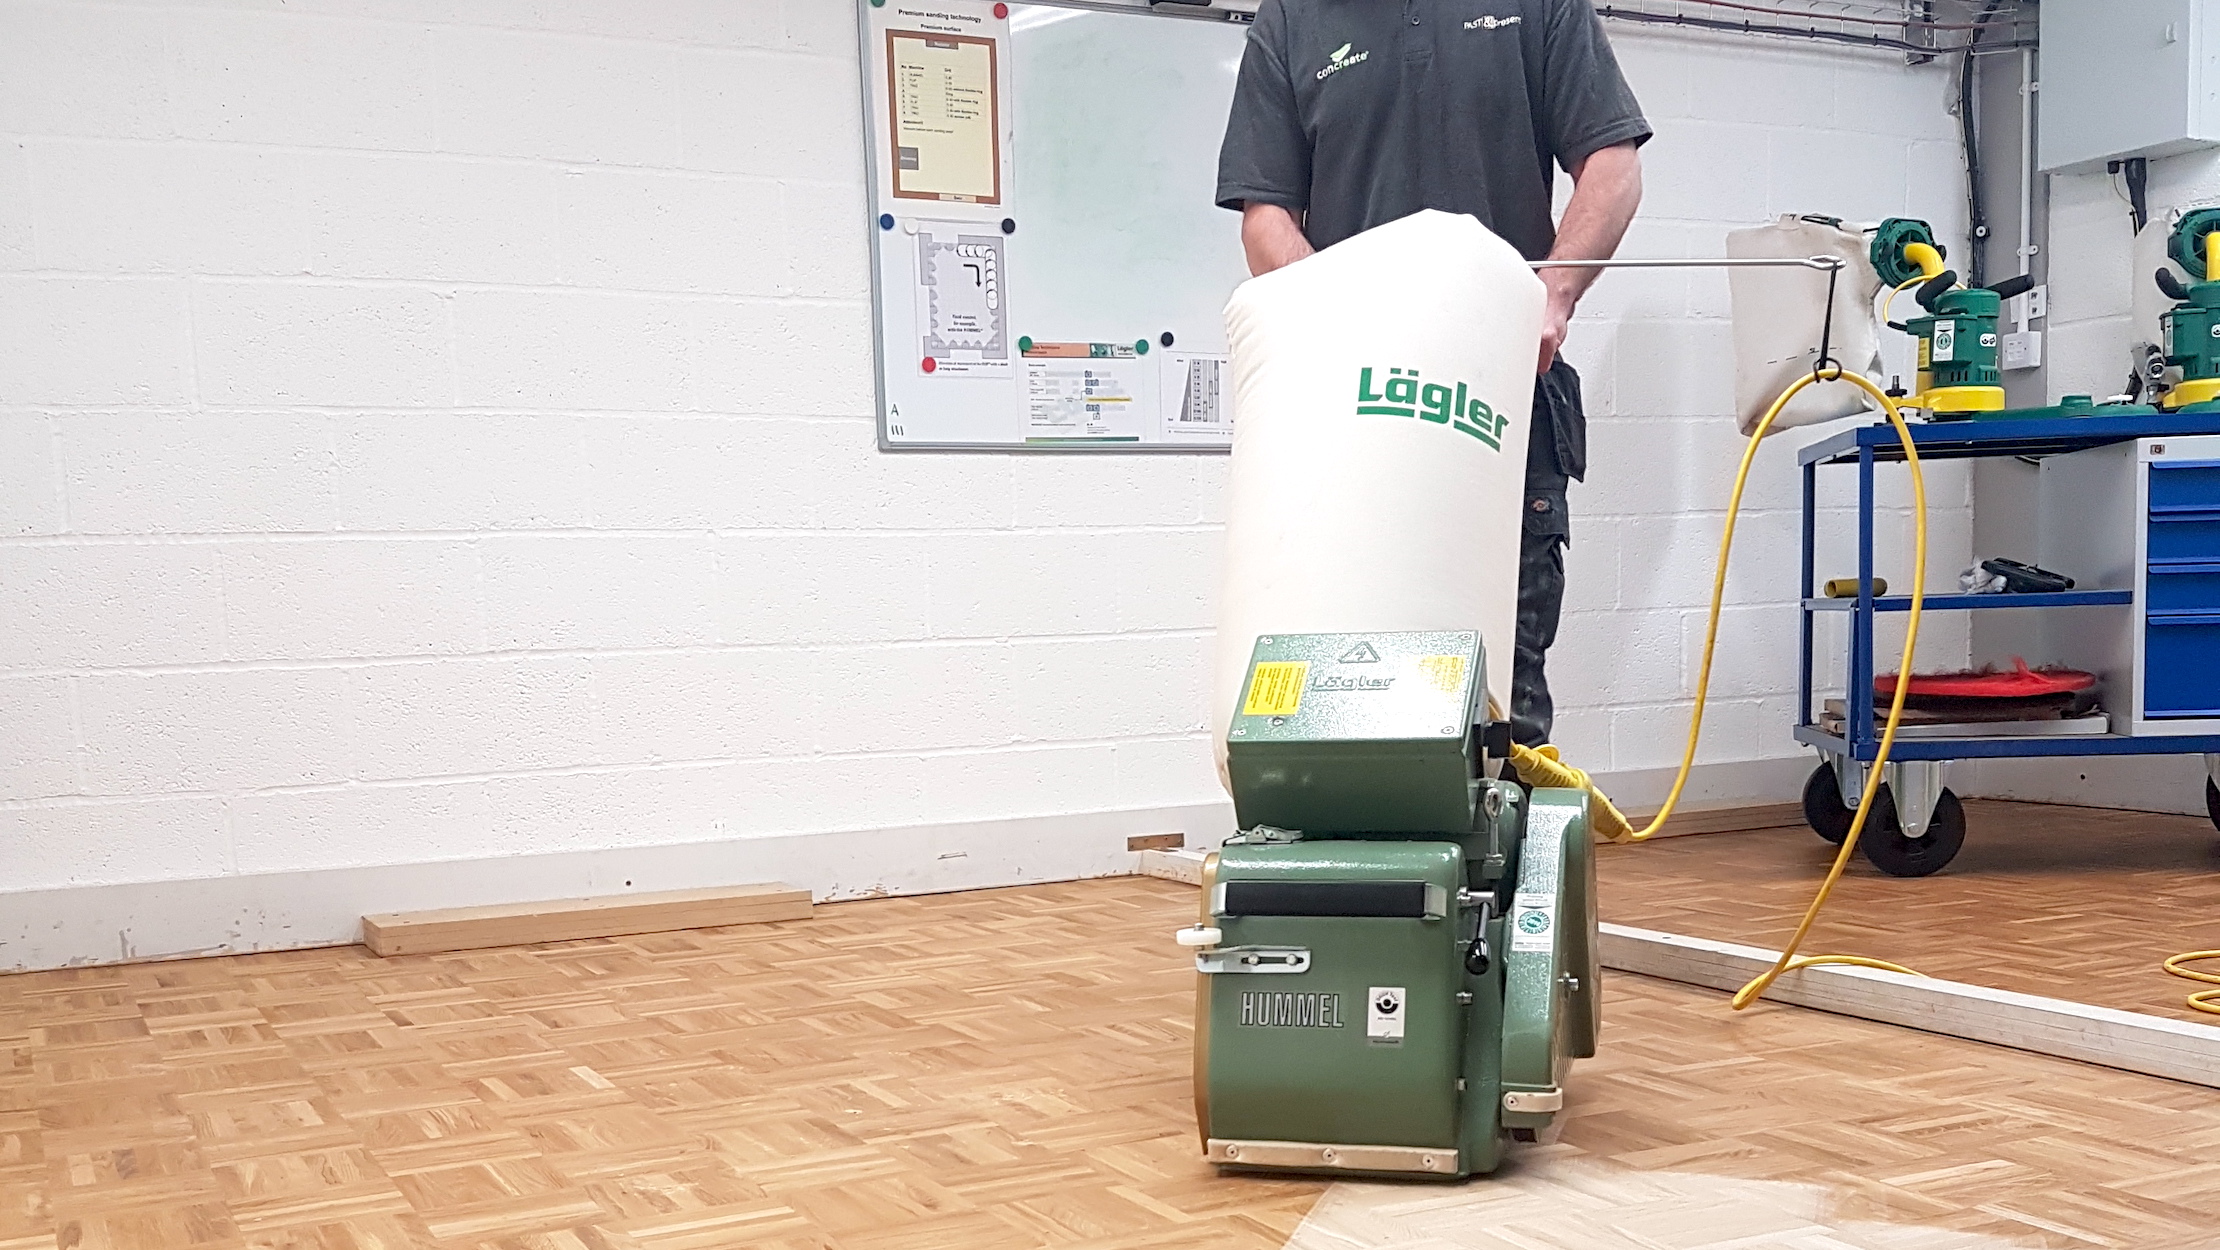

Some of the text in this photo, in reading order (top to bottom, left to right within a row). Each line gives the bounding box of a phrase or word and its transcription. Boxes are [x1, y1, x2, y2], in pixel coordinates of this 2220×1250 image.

[898, 9, 981, 23] Premium sanding technology
[1357, 367, 1510, 452] Lägler
[1241, 991, 1344, 1028] HUMMEL
